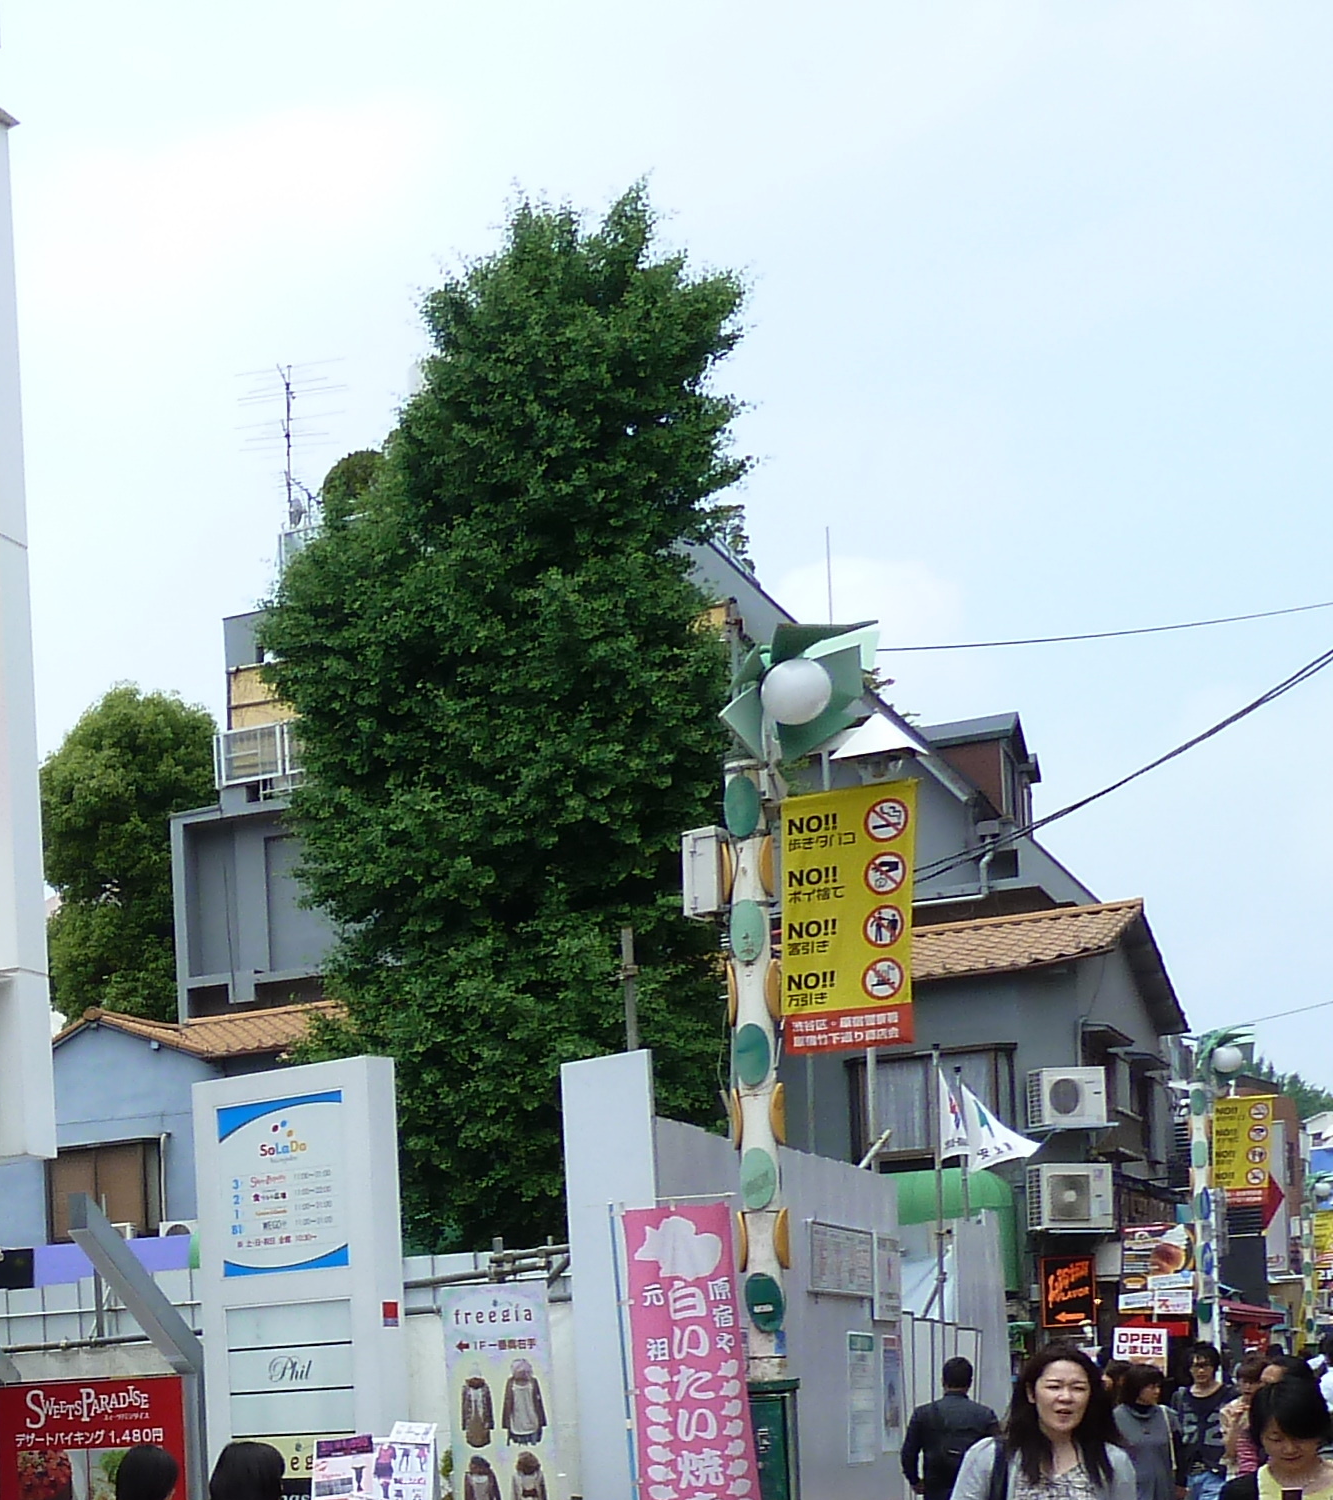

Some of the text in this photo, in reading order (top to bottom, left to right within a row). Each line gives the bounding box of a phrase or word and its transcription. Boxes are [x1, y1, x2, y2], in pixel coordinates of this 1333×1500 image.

[787, 813, 837, 836] NO!!
[788, 831, 856, 851] 歩きタバコ
[787, 866, 838, 887] NO!!
[788, 885, 845, 904] ポイ捨て
[787, 918, 837, 940] NO!!
[788, 940, 830, 956] 客引き
[787, 971, 836, 991] NO!!
[787, 992, 828, 1007] 万引き
[259, 1140, 308, 1157] SoLaDo
[453, 1303, 533, 1325] freegia
[709, 1277, 737, 1355] 原宿や
[1117, 1333, 1163, 1345] OPEN
[1116, 1344, 1164, 1356] しました
[268, 1355, 313, 1382] Phil
[15, 1427, 164, 1448] デザートバイキング 1,480円
